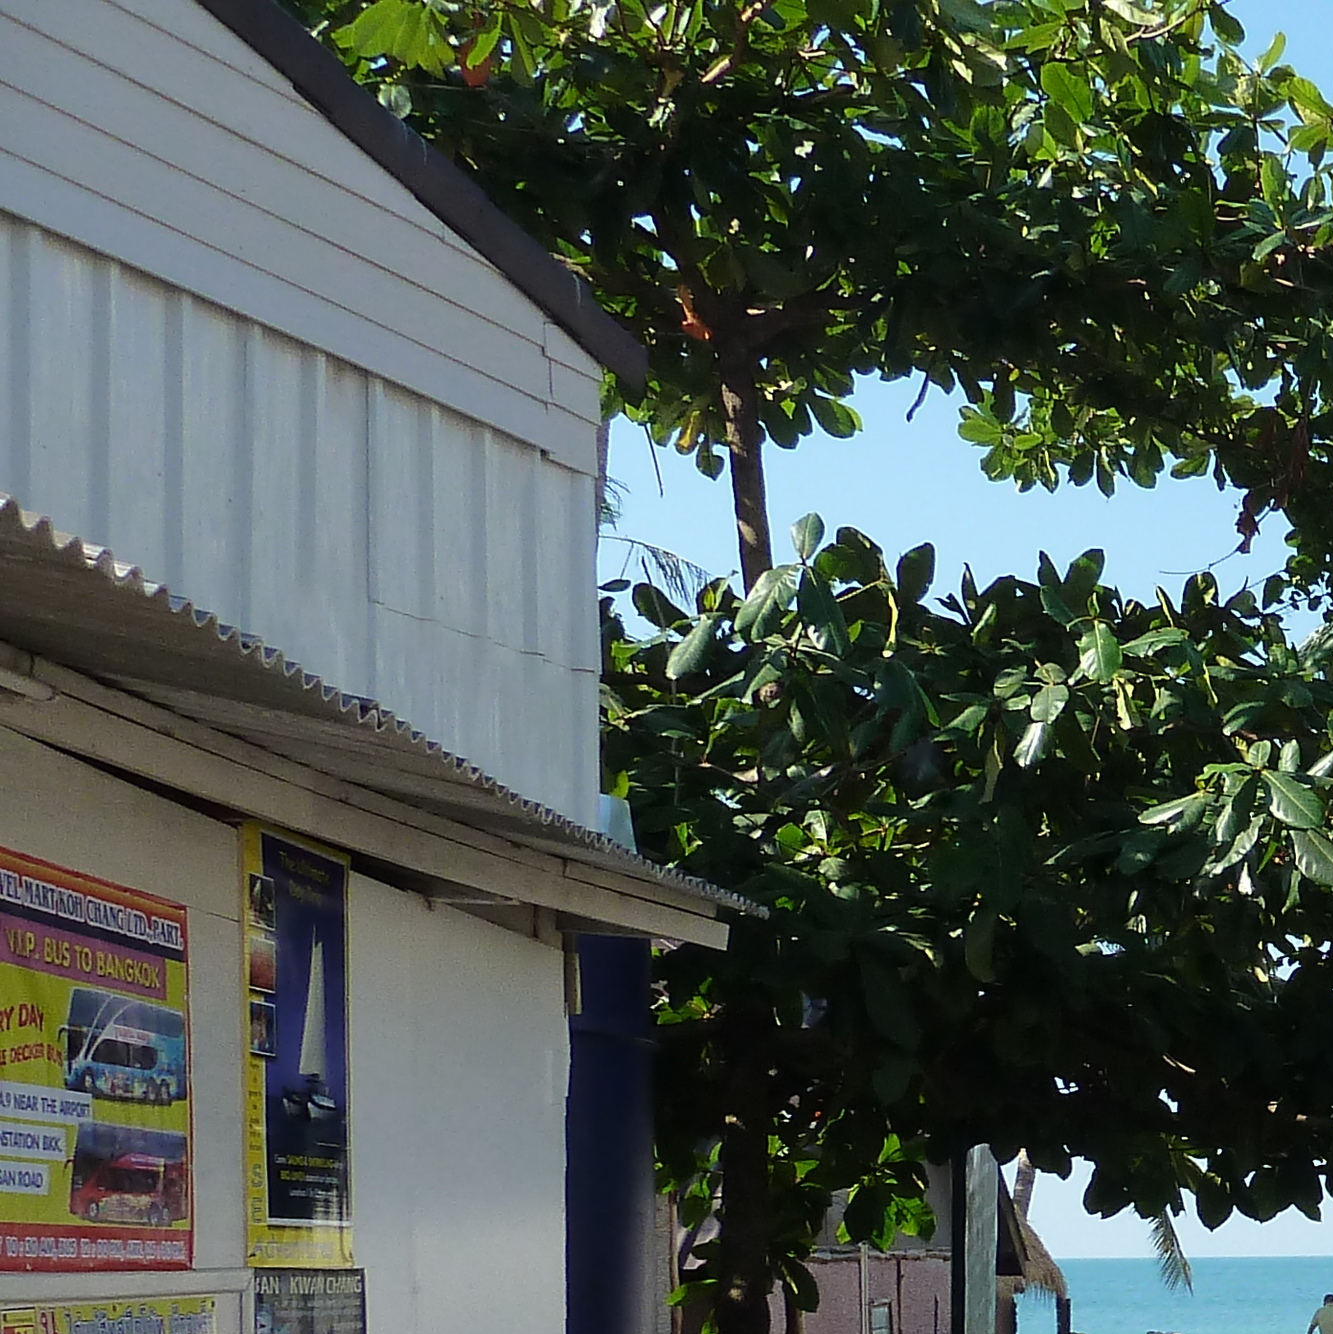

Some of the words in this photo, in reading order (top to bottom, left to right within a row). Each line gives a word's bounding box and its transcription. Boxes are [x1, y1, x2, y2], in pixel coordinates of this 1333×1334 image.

[23, 878, 56, 913] MART
[58, 888, 84, 921] KOH
[86, 899, 124, 931] CHANG
[43, 937, 71, 967] BUS
[73, 944, 92, 972] TO
[97, 952, 161, 989] BANGKOK
[18, 1002, 44, 1032] DAY
[10, 1042, 44, 1063] DECKER
[13, 1092, 39, 1112] NEAR
[40, 1096, 57, 1114] THE
[59, 1100, 90, 1118] AIRPORT
[17, 1169, 44, 1189] ROAD
